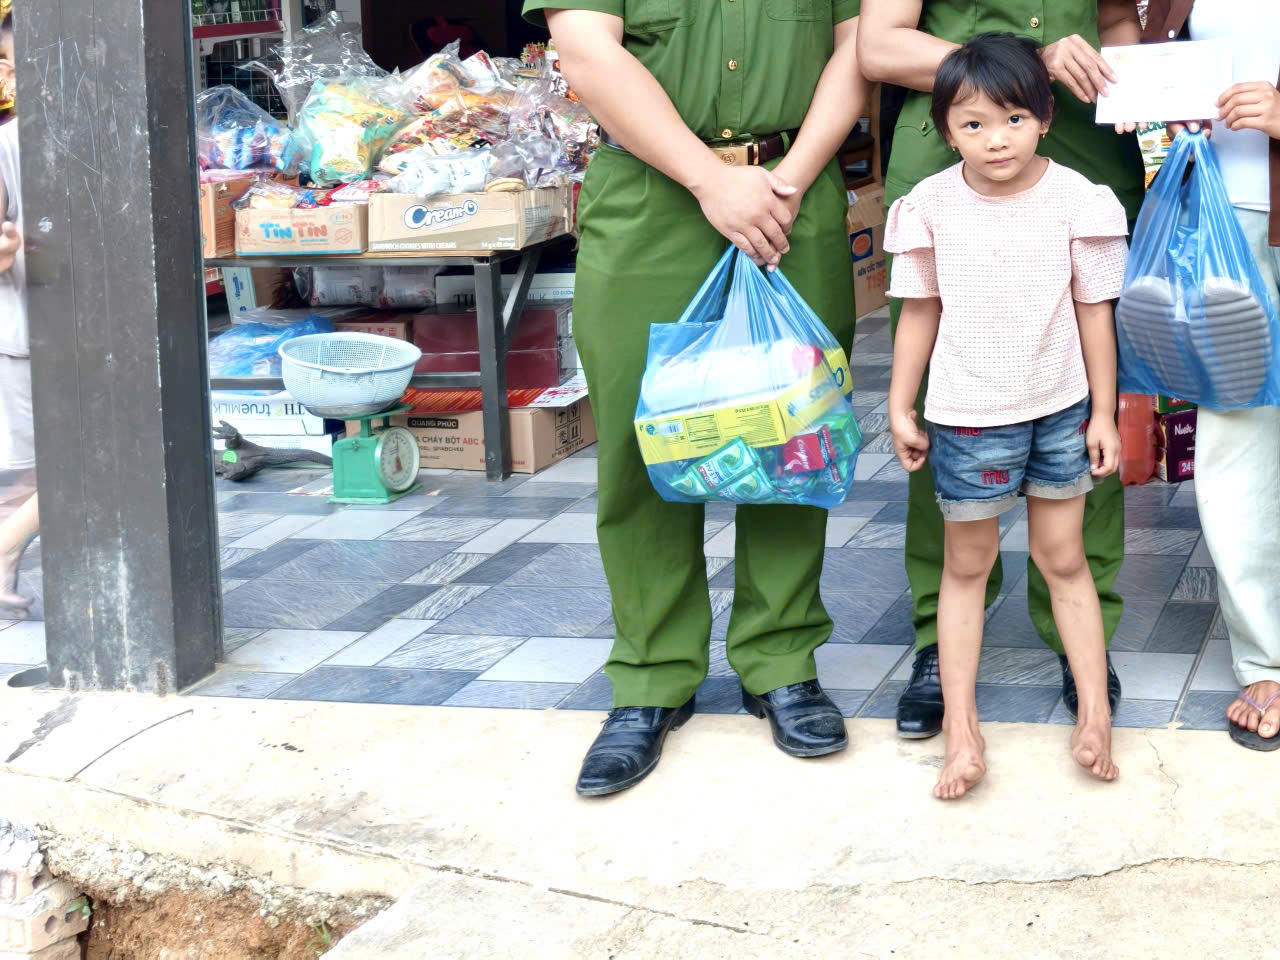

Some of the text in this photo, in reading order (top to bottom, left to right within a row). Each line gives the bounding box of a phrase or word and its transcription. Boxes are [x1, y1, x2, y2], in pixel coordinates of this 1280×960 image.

[411, 419, 436, 427] QUANG
[462, 437, 479, 445] ABC
[1181, 462, 1192, 473] 24
